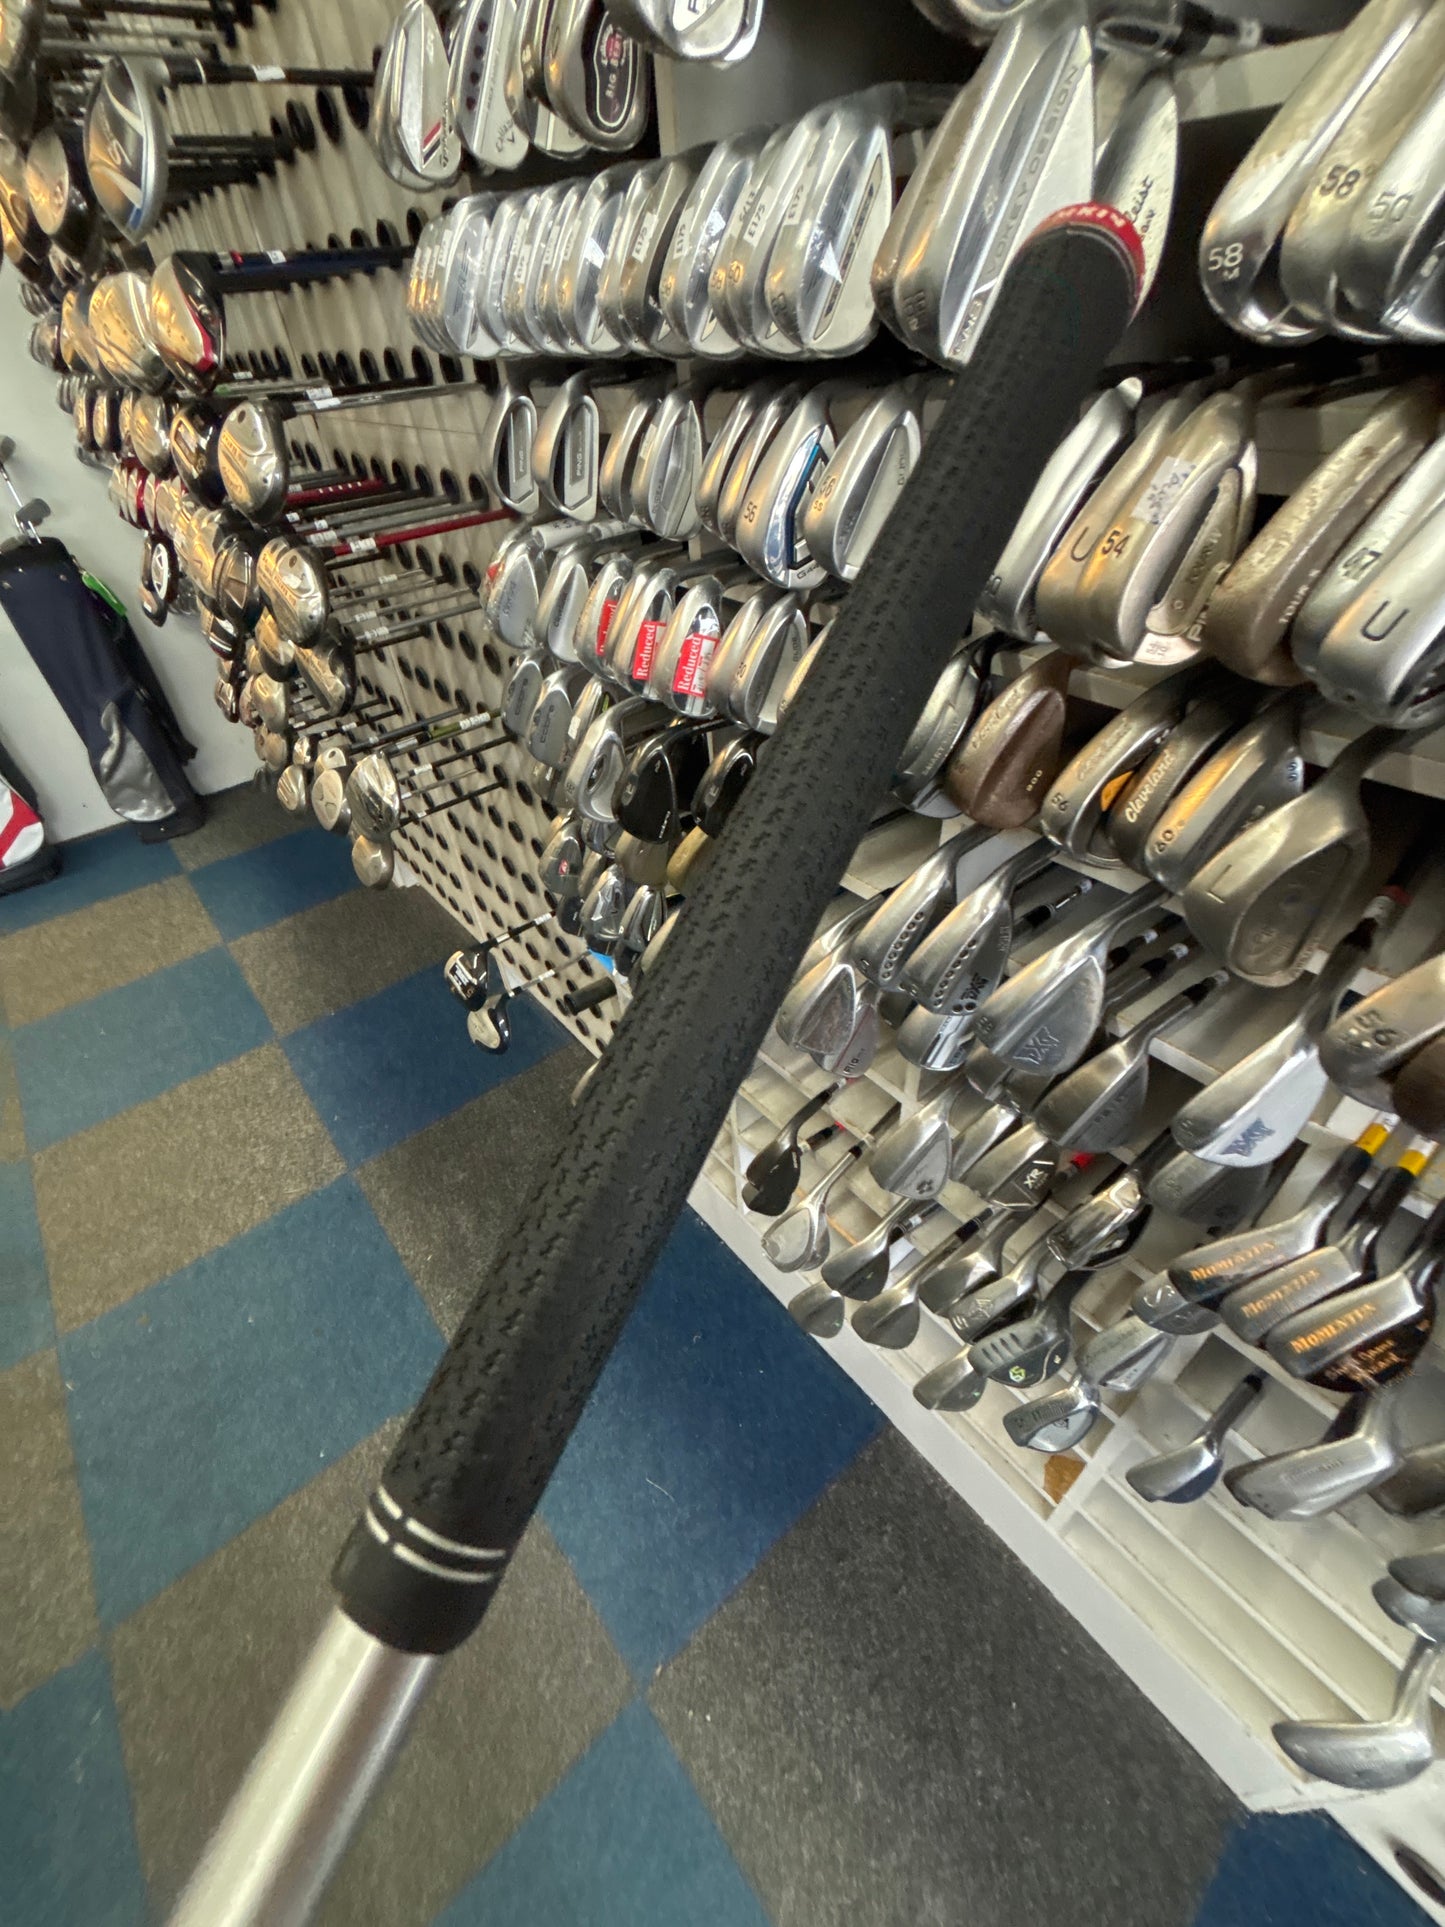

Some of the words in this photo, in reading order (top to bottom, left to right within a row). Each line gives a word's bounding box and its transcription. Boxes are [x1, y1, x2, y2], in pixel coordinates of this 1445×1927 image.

[1028, 67, 1080, 176] DESIGN
[1319, 164, 1361, 200] 58
[748, 204, 767, 239] £175
[1207, 241, 1244, 272] 58
[1101, 529, 1131, 559] 54
[635, 623, 656, 678] Reduced
[676, 635, 701, 692] Reduced
[1050, 792, 1069, 813] 56
[1123, 749, 1177, 824] Cleveland
[1153, 829, 1175, 854] 60
[1354, 1008, 1399, 1047] 56
[1023, 1167, 1043, 1187] XR
